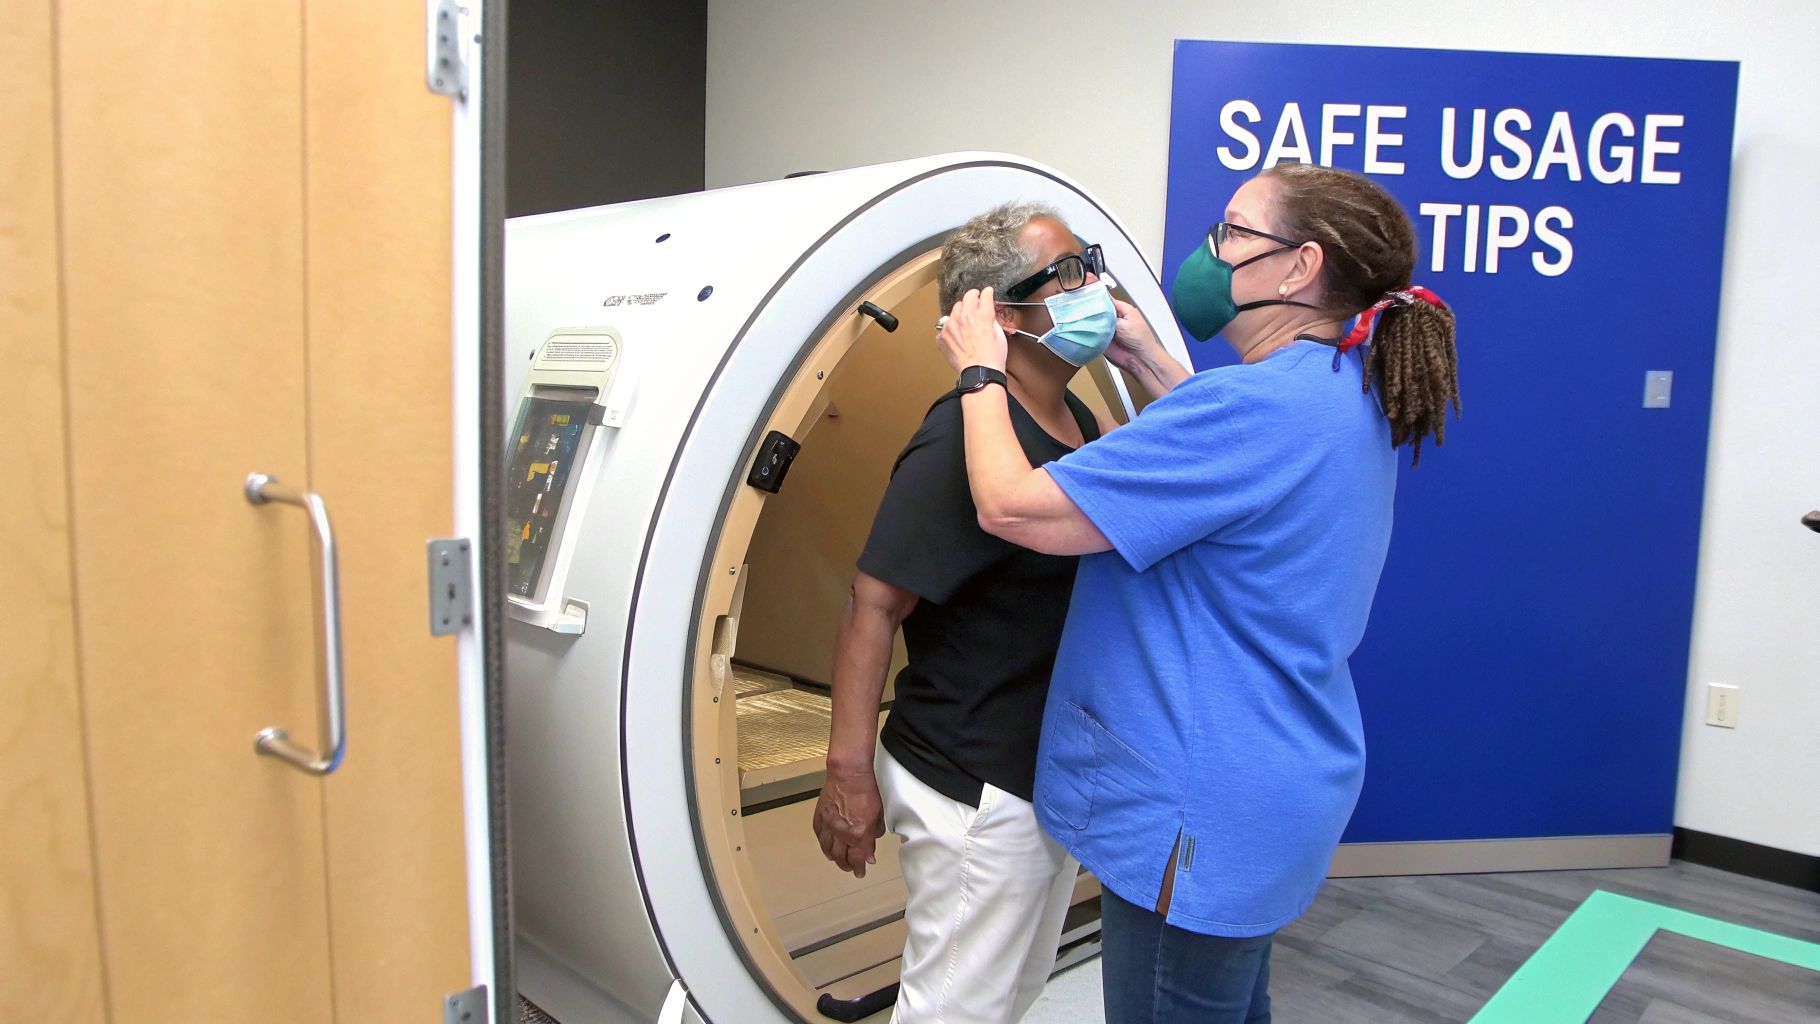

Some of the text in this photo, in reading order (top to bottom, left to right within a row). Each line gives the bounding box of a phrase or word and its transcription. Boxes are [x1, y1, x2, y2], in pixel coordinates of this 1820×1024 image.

[1216, 99, 1685, 184] SAFE USAGE
[1419, 202, 1574, 277] TIPS
